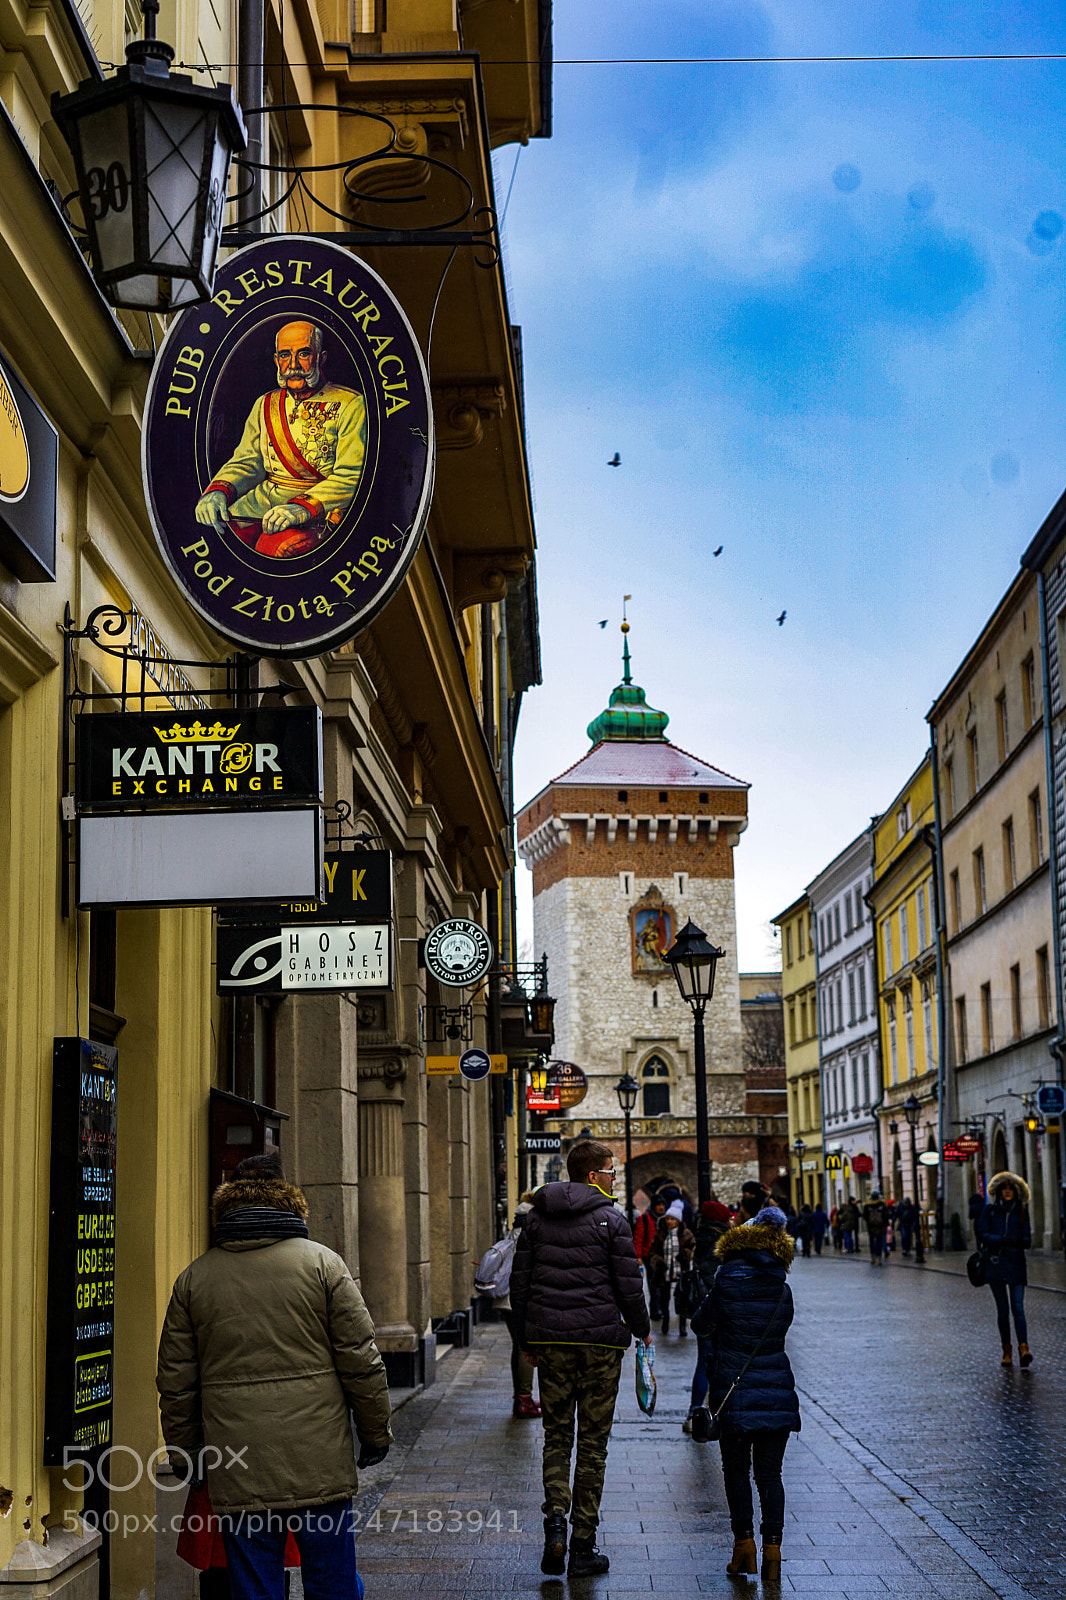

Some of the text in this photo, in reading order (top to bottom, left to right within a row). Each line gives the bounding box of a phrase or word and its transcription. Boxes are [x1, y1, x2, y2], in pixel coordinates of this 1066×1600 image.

[87, 161, 128, 221] 30
[165, 259, 411, 419] PUB RESTAURACJA
[180, 535, 396, 623] Pod Złotą Pipą
[112, 742, 283, 778] KANTOR
[112, 776, 284, 795] EXCHANGE
[289, 930, 383, 954] HOSZ
[428, 922, 488, 953] ROCK'N'ROLL
[289, 954, 383, 970] GABINET
[431, 960, 484, 981] TATTOO STUDIO
[288, 969, 383, 983] OPTOMETRYCZNY
[556, 1064, 572, 1075] 36
[81, 1072, 116, 1103] KANTOR
[525, 1138, 561, 1149] TATTOO
[93, 1167, 106, 1182] SELL
[78, 1214, 98, 1240] EUR
[77, 1248, 97, 1274] USD
[76, 1283, 97, 1310] GBP
